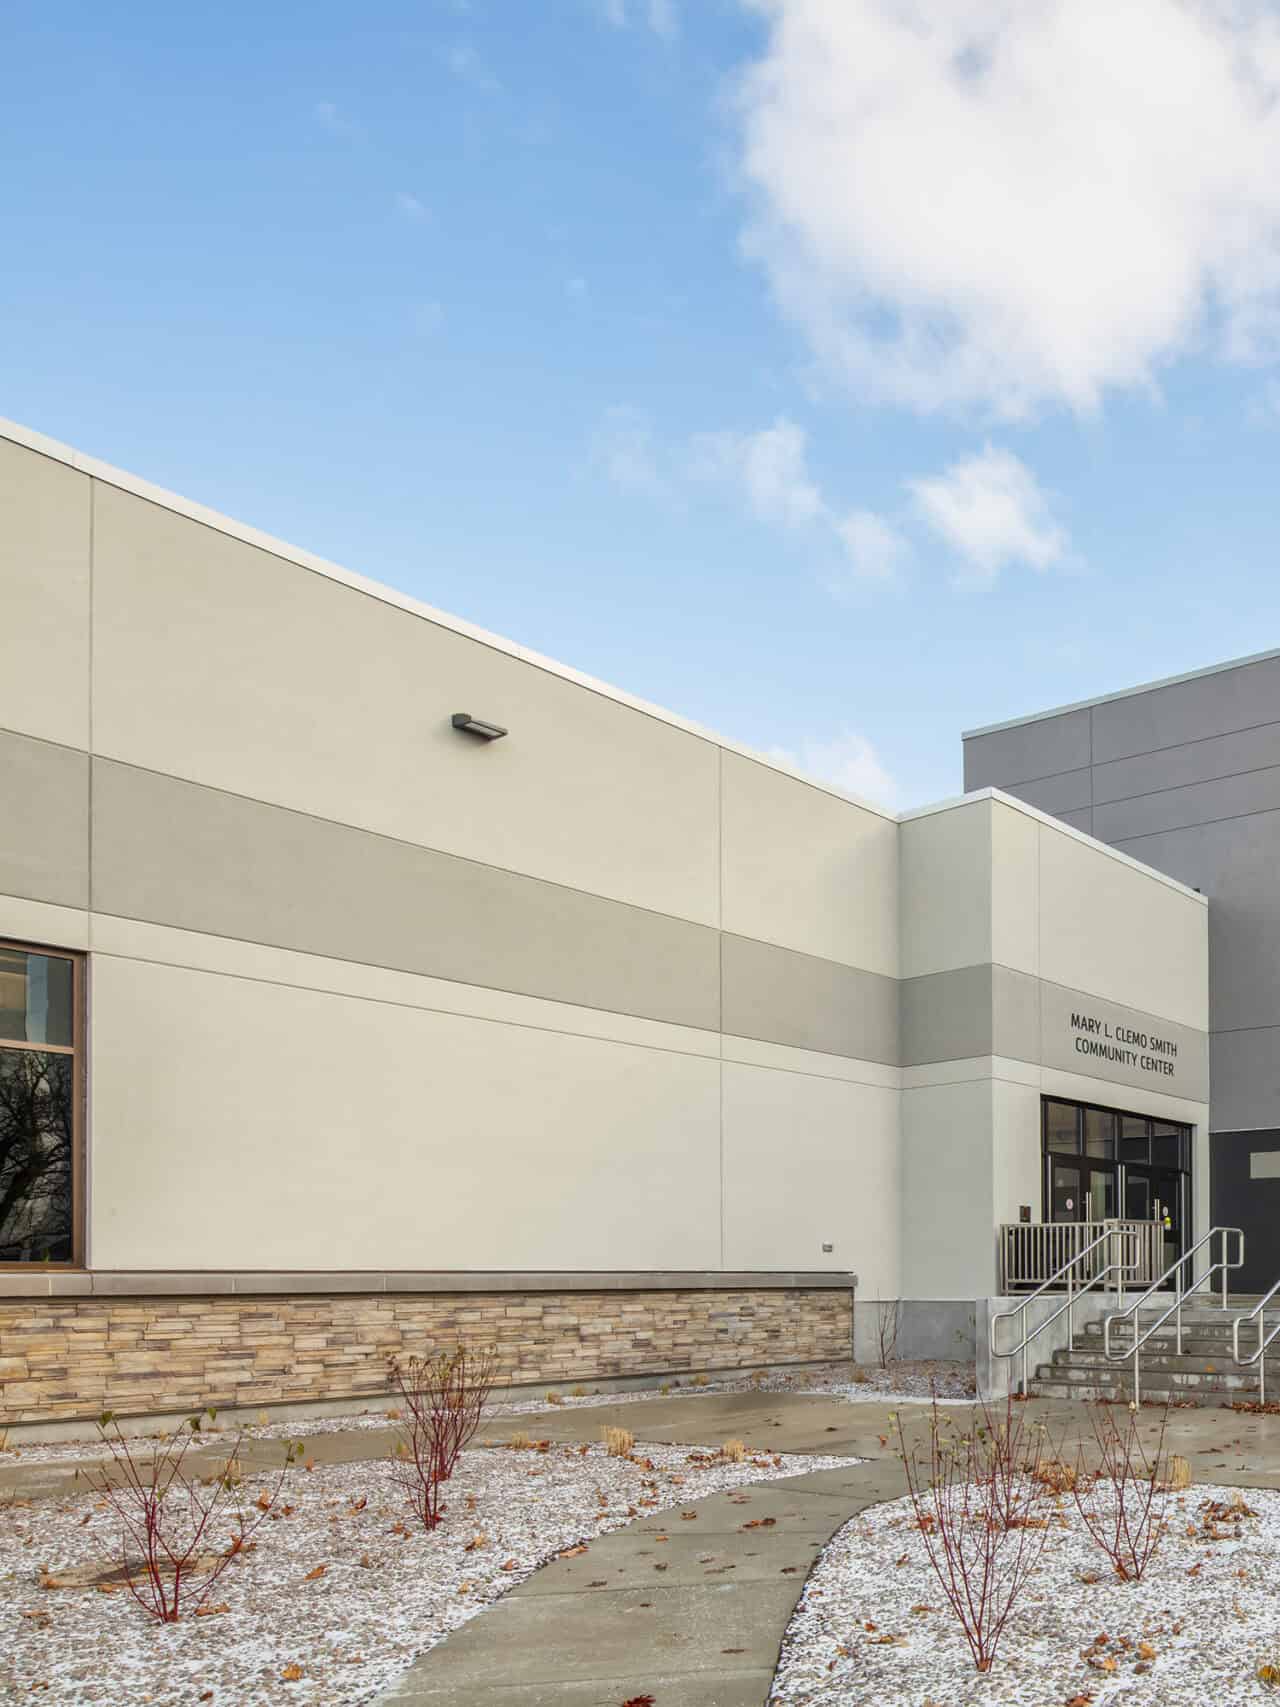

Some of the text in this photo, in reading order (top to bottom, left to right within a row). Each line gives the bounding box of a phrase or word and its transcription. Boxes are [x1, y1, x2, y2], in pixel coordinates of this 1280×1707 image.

[1071, 1013, 1177, 1057] MARY L. CLEMO SMITH
[1075, 1037, 1174, 1077] COMMUNITY CENTER
